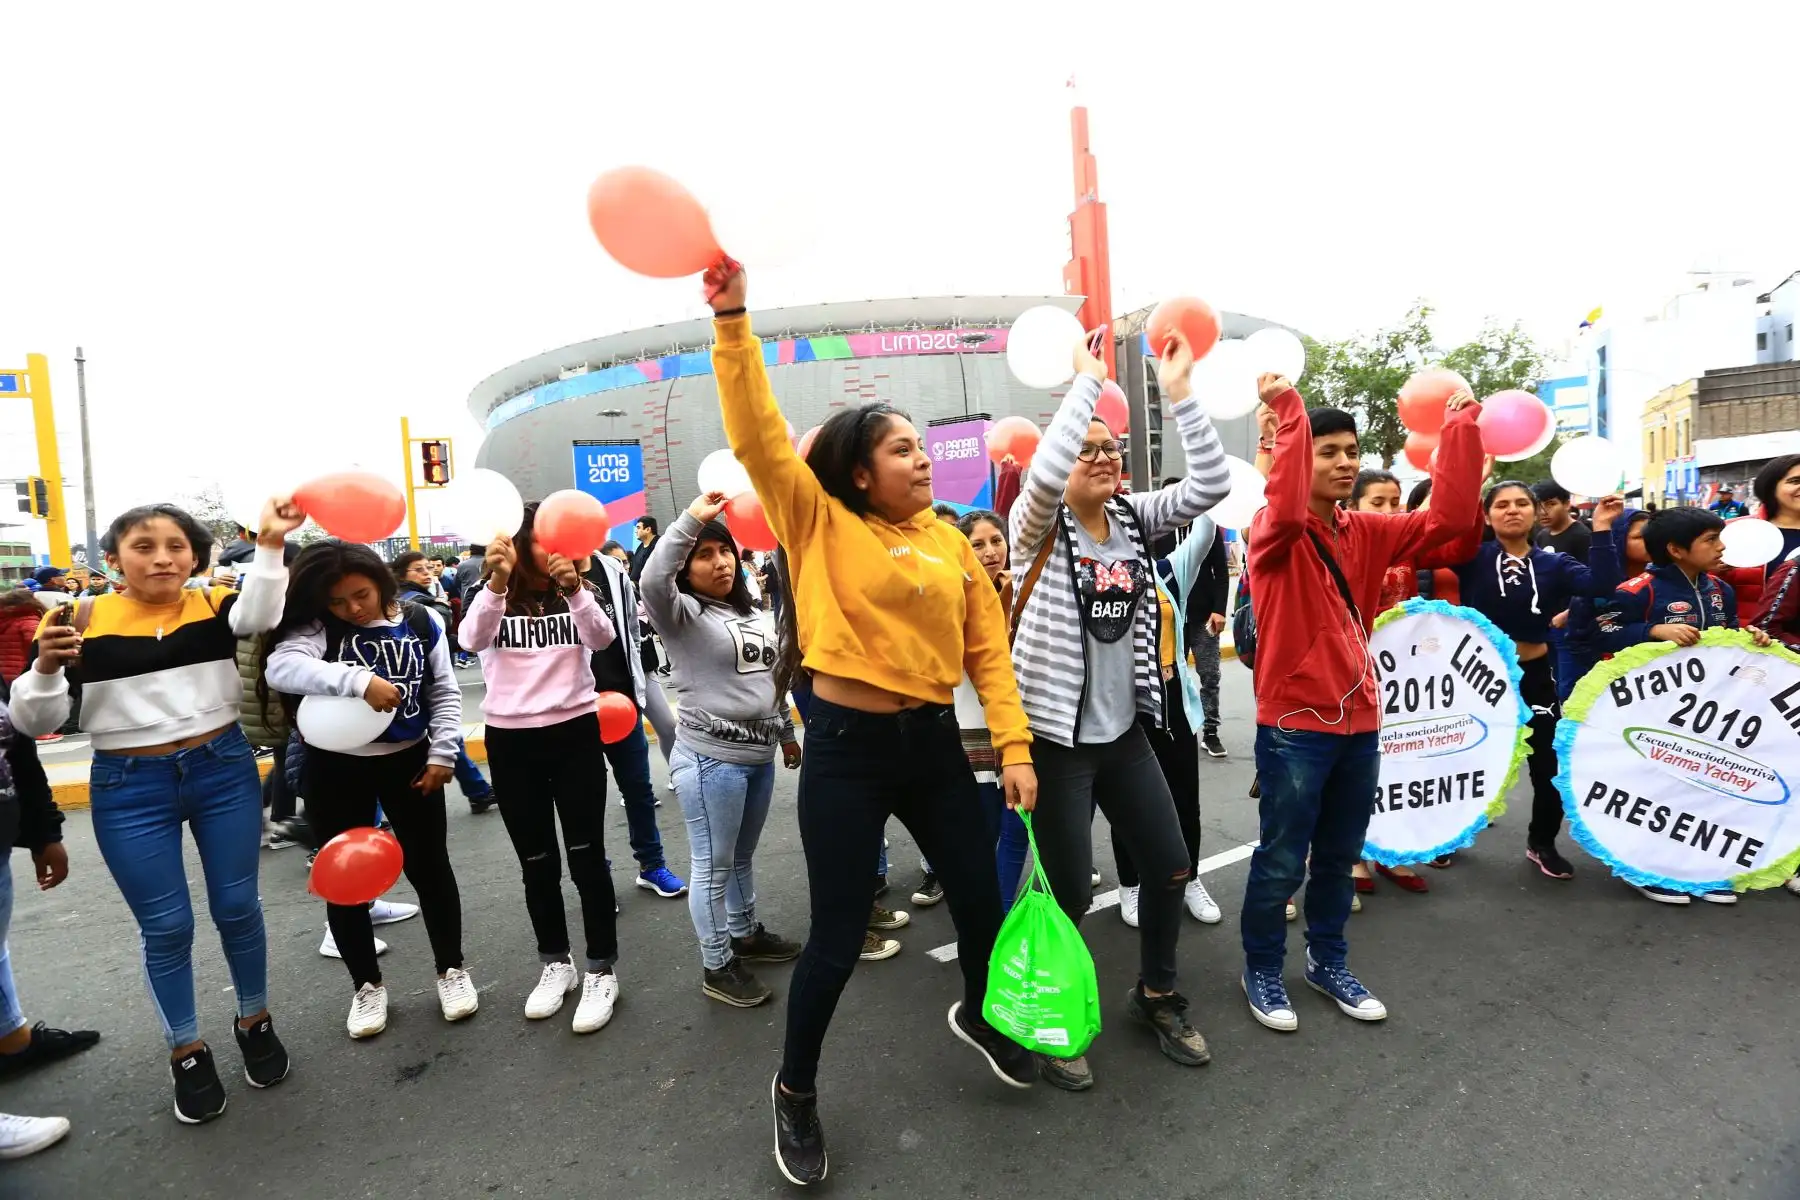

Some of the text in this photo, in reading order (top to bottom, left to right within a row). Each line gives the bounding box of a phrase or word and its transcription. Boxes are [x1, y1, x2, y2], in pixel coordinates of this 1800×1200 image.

[588, 467, 630, 483] 2019
[945, 448, 980, 460] SPORTS
[1091, 600, 1132, 618] BABY
[494, 615, 583, 649] ALIFORNI
[1450, 633, 1507, 708] Lima
[1609, 657, 1706, 708] Bravo
[1384, 673, 1454, 715] 2019
[1380, 717, 1474, 742] uela sociodeportiva
[1426, 731, 1466, 752] Yachay
[1667, 692, 1763, 749] 2019
[1635, 732, 1777, 783] Escuela sociodeportiva
[1650, 745, 1701, 772] Warma
[1703, 762, 1757, 793] Yachay
[1371, 769, 1485, 815] RESENTE
[1583, 780, 1765, 869] PRESENTE
